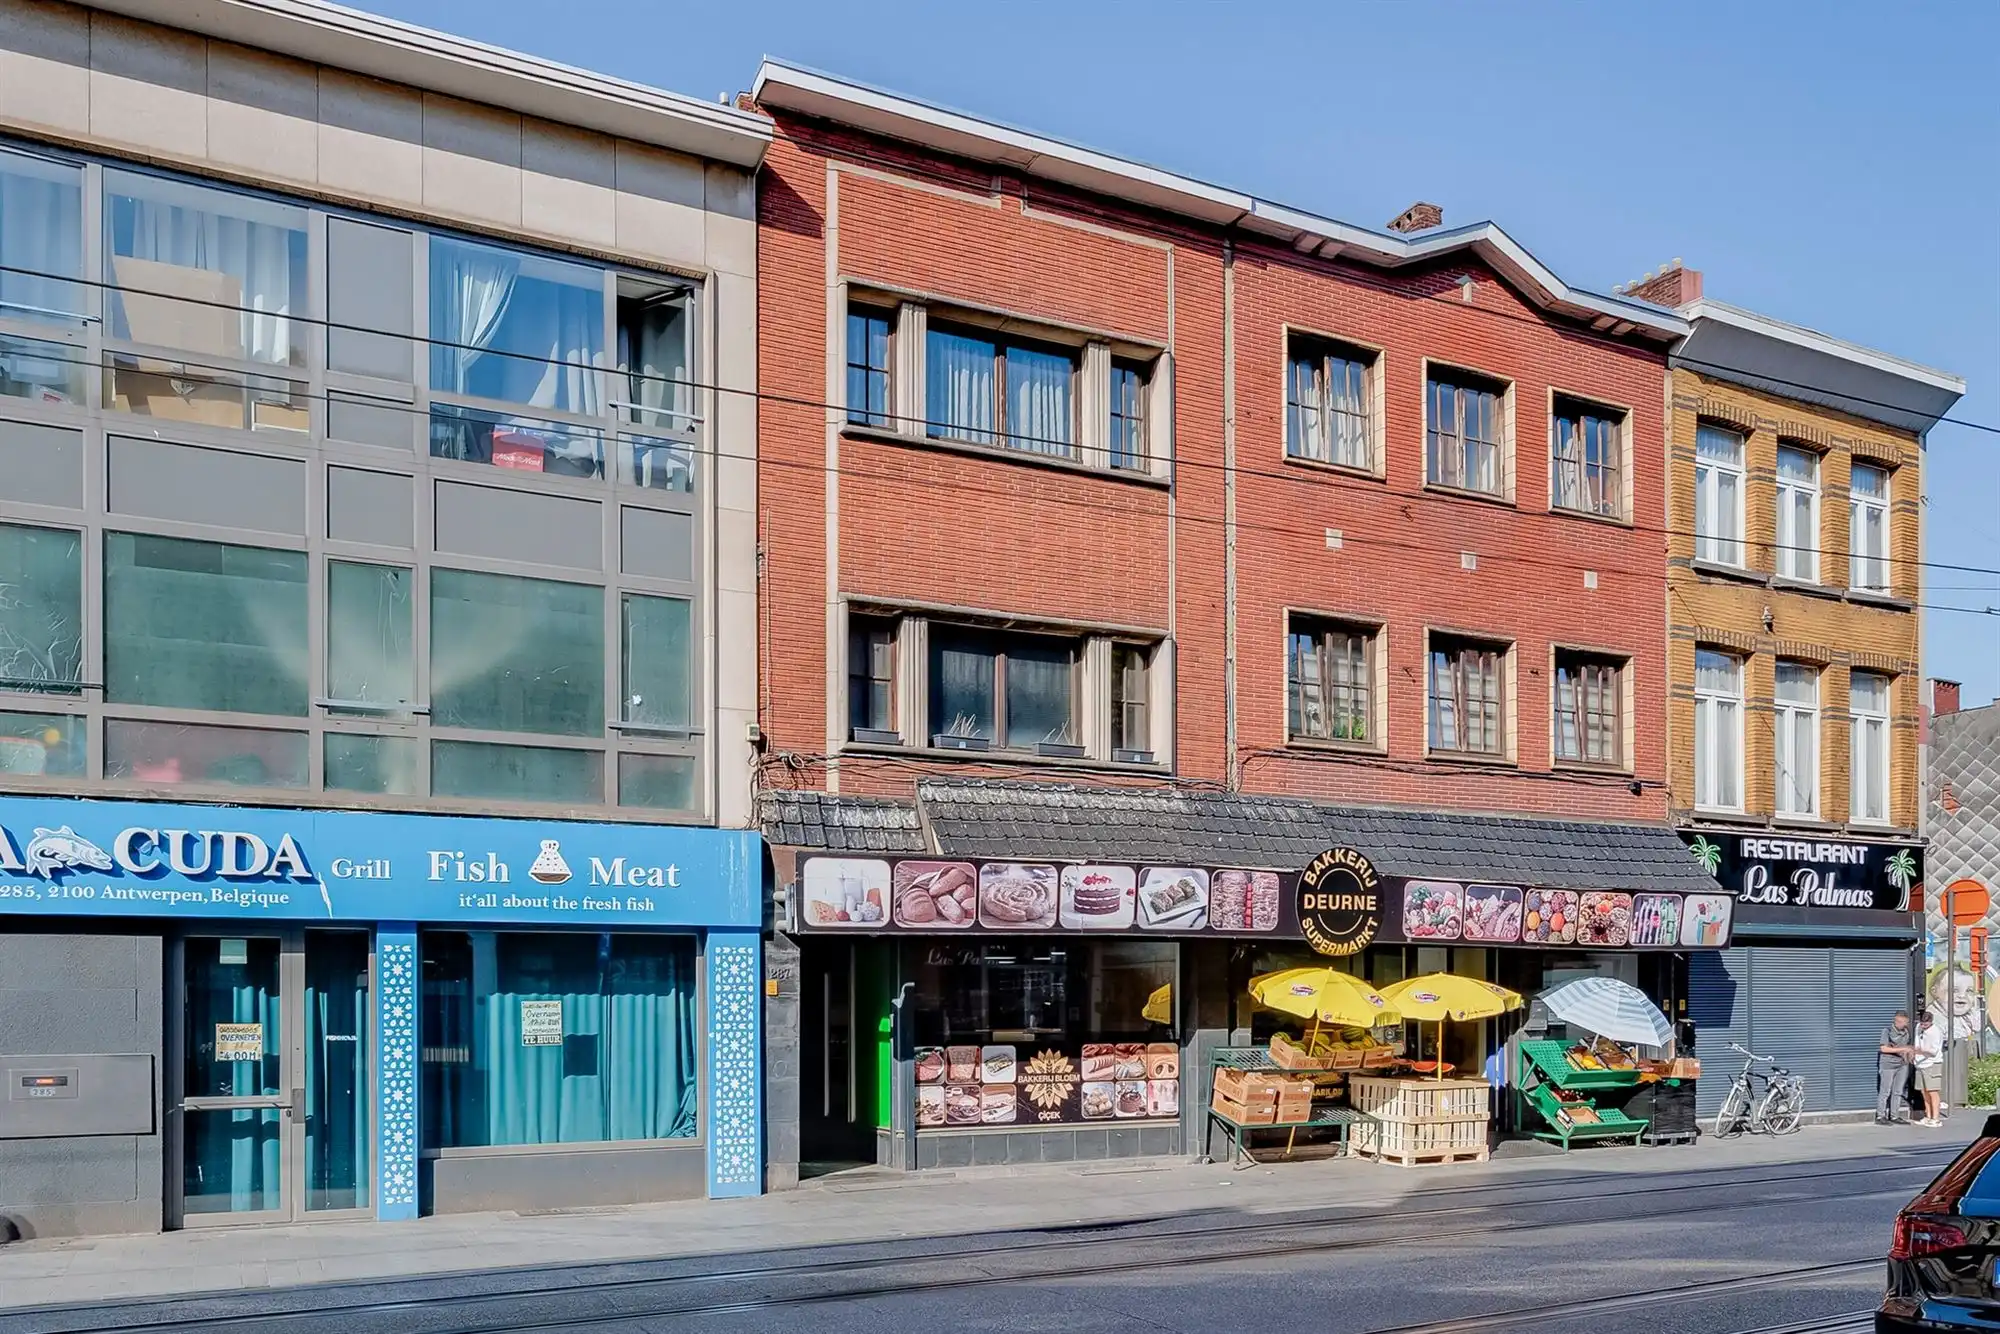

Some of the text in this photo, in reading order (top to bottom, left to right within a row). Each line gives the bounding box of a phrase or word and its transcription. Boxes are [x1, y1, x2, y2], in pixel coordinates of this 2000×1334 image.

[114, 827, 312, 877] CUDA
[1740, 838, 1868, 864] RESTAURANT
[331, 858, 392, 880] Grill
[427, 850, 681, 887] Fish Meat
[1303, 848, 1377, 888] BAKKERIJ
[0, 885, 289, 908] 285, 2100 Antwerpen, Belgique
[1740, 865, 1873, 907] Las Palmas
[503, 894, 549, 908] about
[553, 896, 578, 910] the
[583, 896, 621, 910] fresh
[627, 897, 655, 911] fish
[1303, 893, 1377, 911] DEURNE
[1302, 916, 1378, 954] SUPERMARKT
[524, 1035, 561, 1044] TE HUUR
[1018, 1074, 1080, 1083] BAKKERIJ BLOEM
